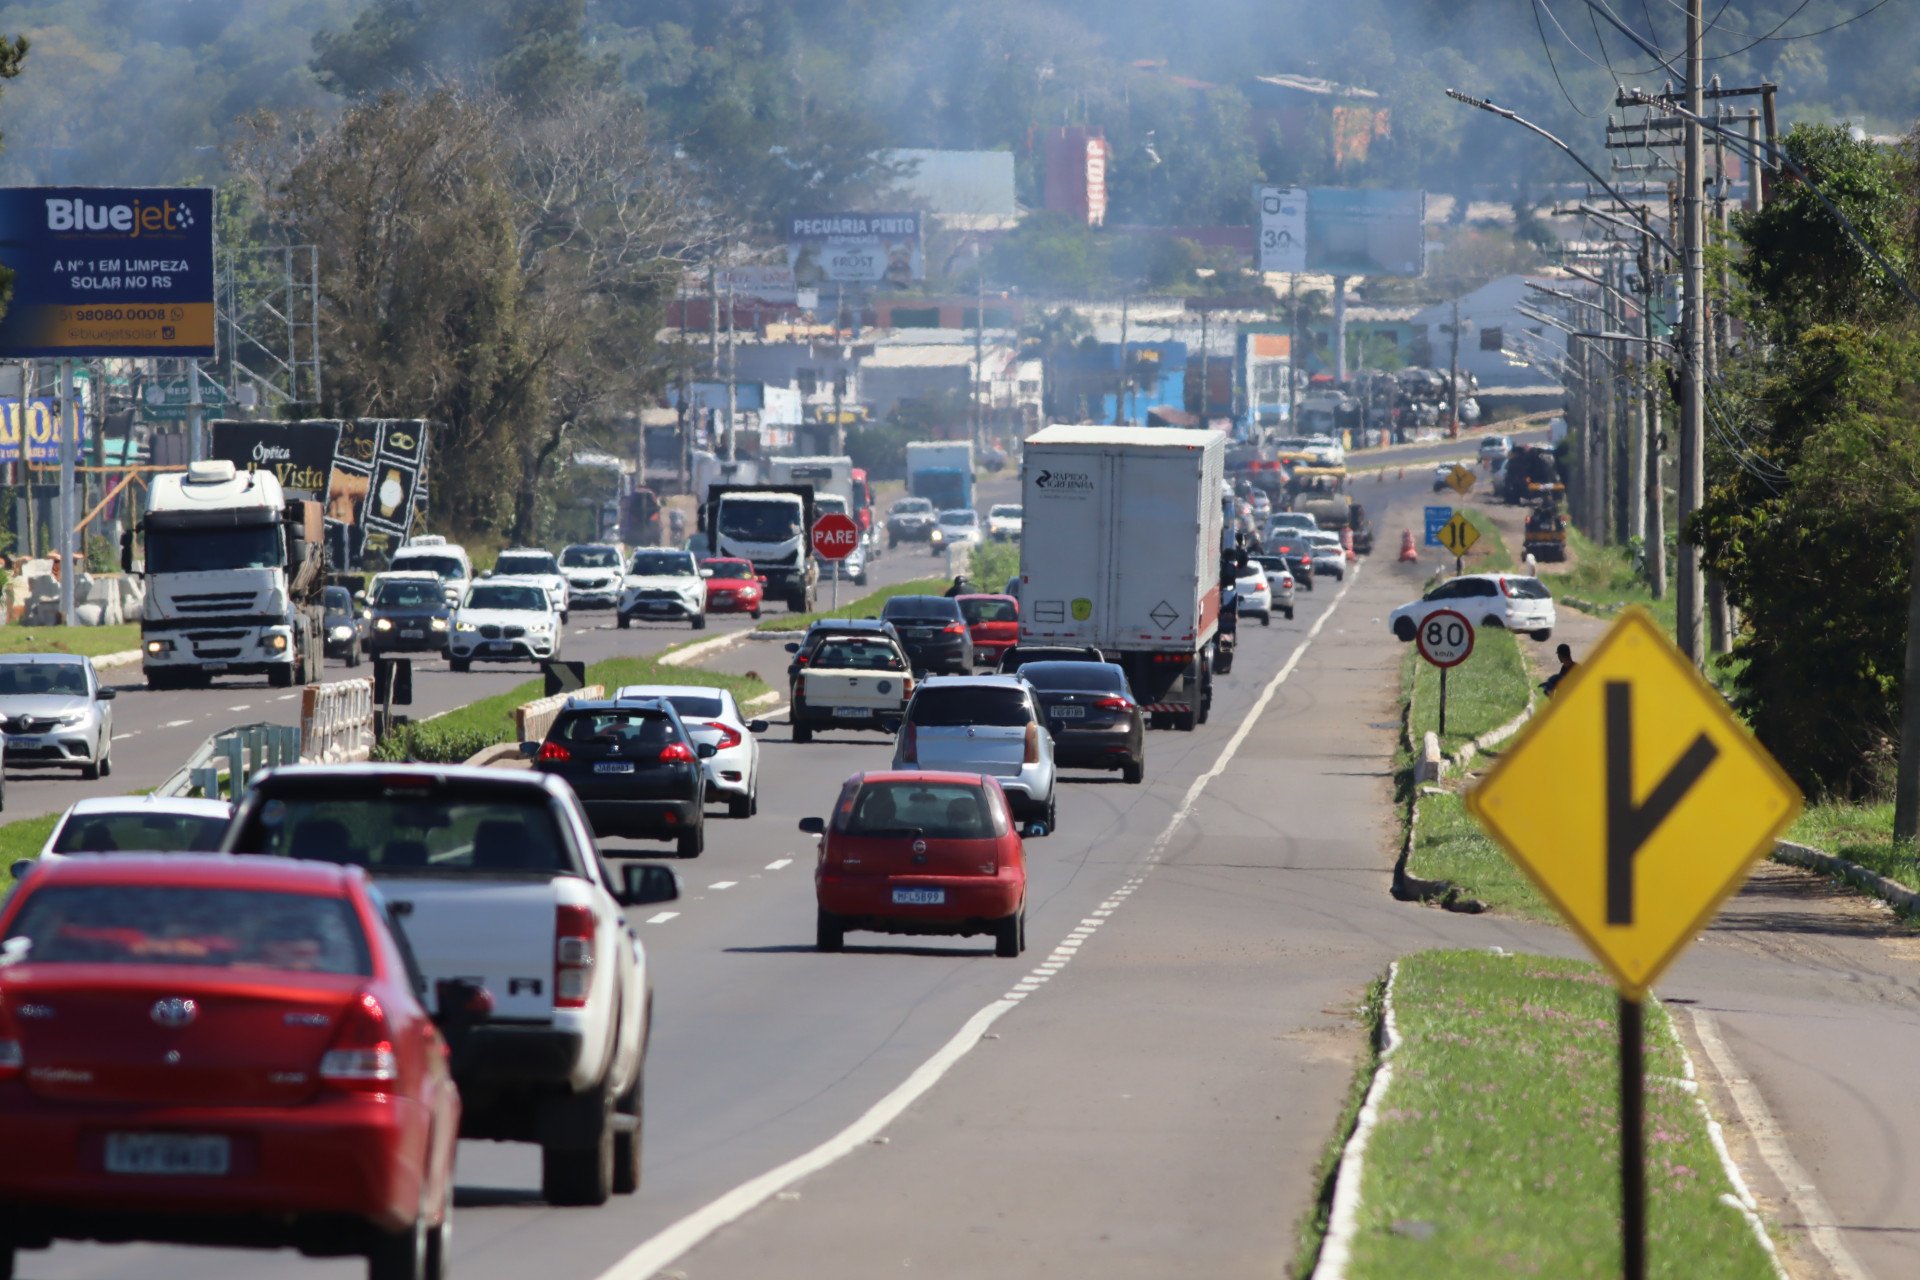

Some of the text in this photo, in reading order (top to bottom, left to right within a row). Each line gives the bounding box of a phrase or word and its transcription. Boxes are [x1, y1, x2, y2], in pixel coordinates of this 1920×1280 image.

[45, 198, 177, 238] Bluejet
[871, 217, 915, 234] PINTO
[54, 260, 64, 272] A
[88, 260, 95, 272] 1
[99, 260, 121, 272] EM
[125, 259, 189, 272] LIMPEZA
[71, 276, 172, 289] SOLAR NO RS
[252, 440, 290, 464] Óptica
[275, 463, 324, 488] Vista
[815, 530, 854, 544] PARE
[1426, 622, 1464, 647] 80
